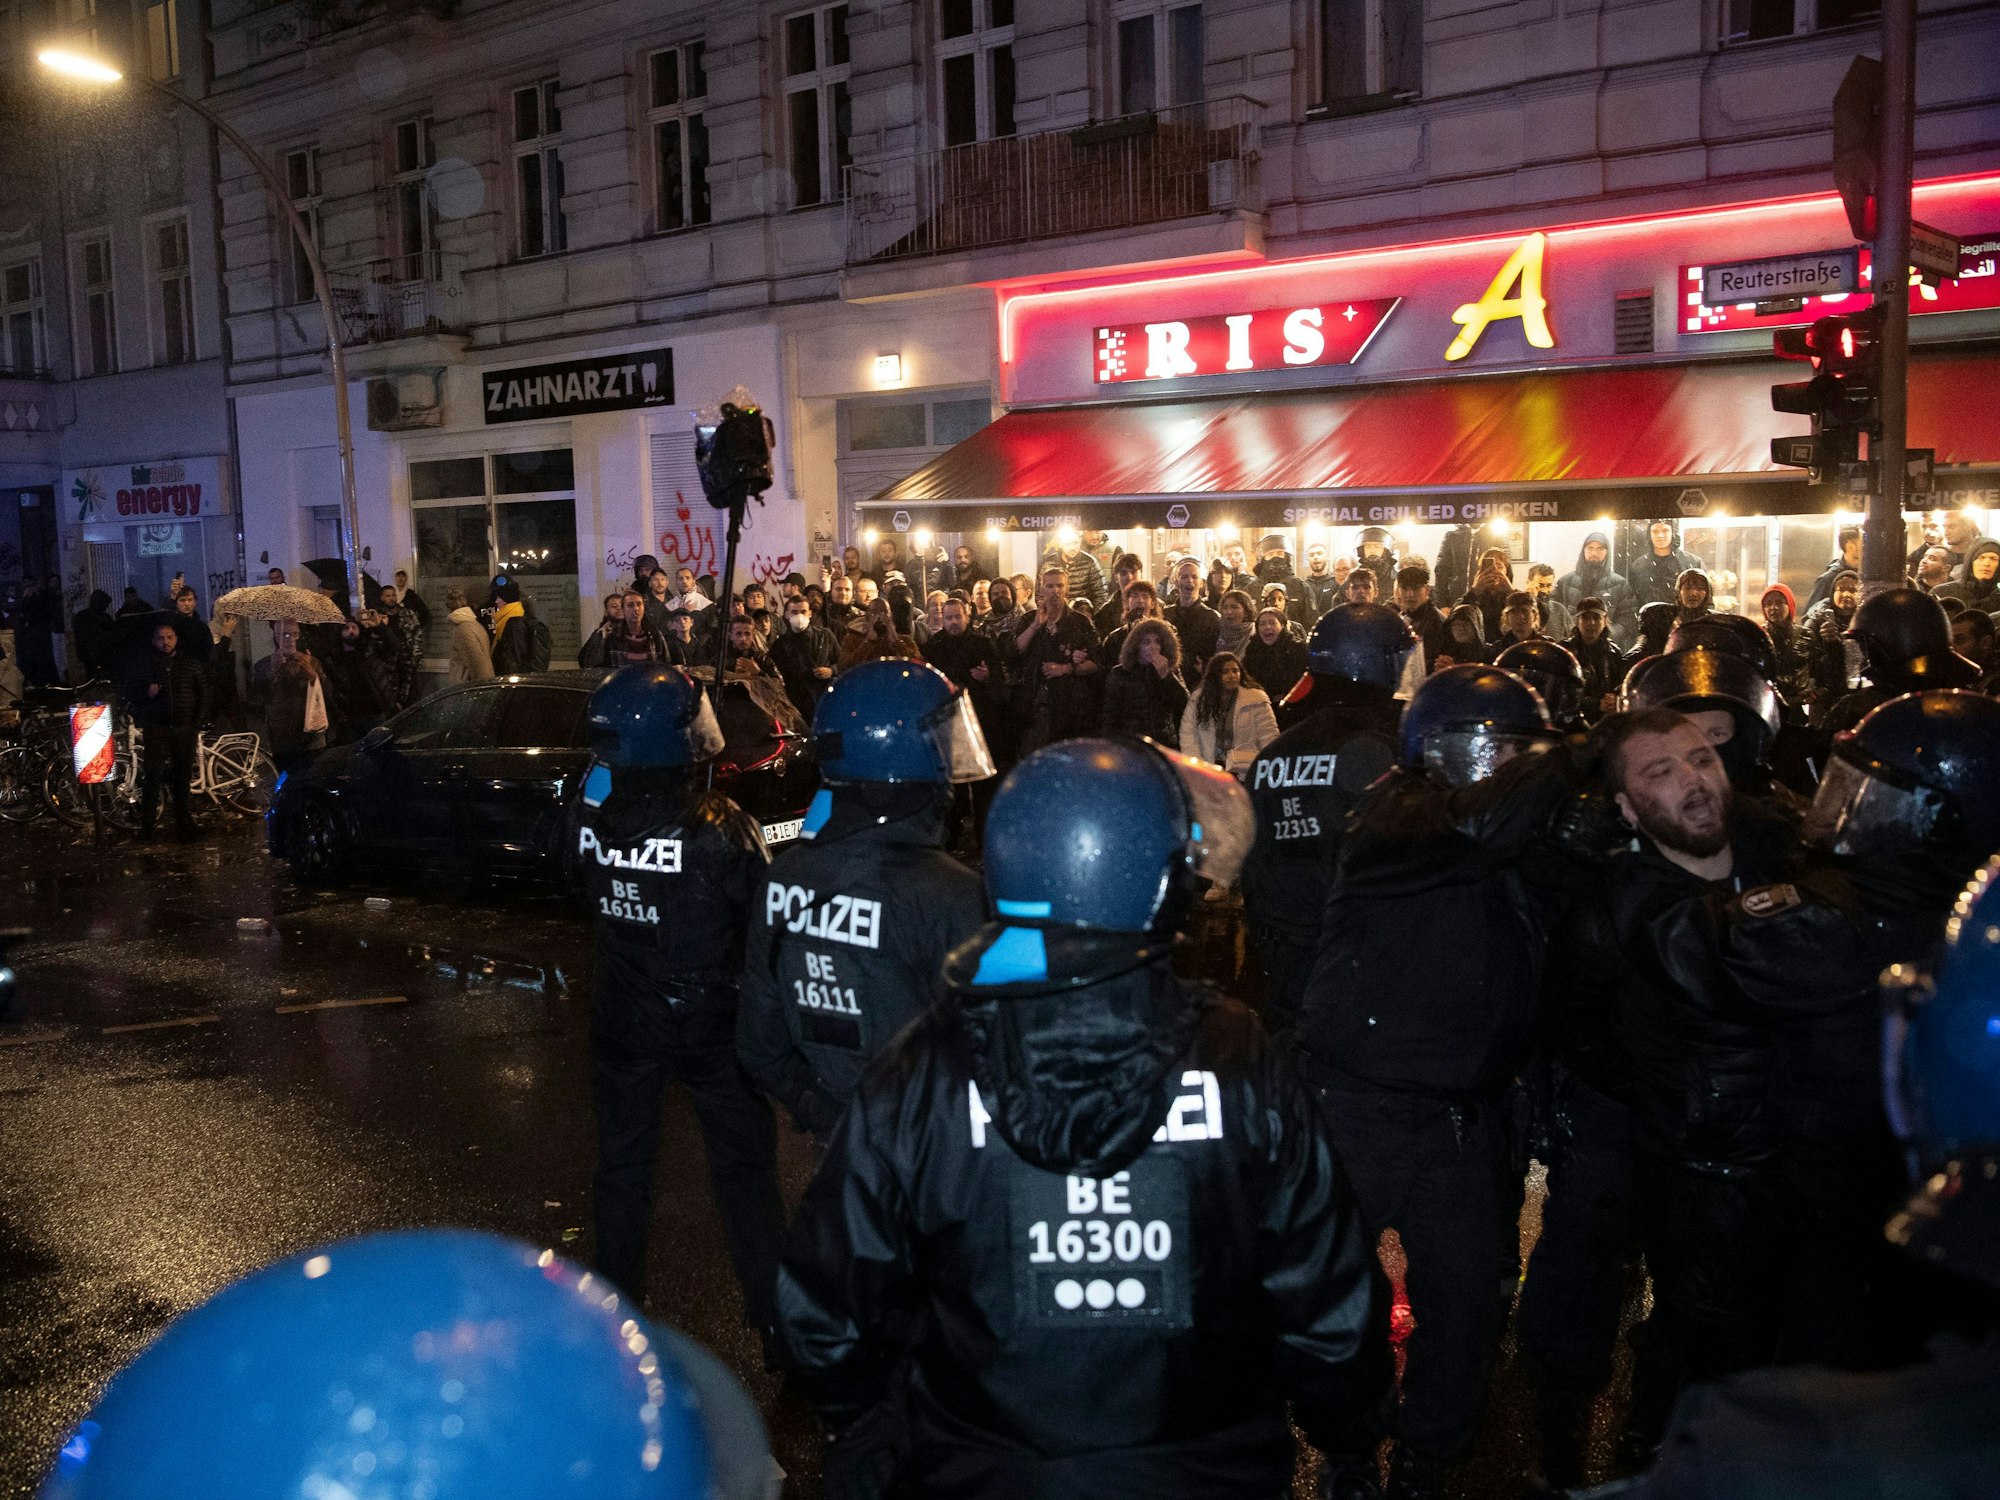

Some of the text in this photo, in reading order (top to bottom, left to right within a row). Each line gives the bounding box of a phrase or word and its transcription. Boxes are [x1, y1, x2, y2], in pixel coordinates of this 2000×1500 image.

[1721, 261, 1841, 292] Reuterstraße
[1959, 259, 1995, 278] الفح
[1445, 232, 1556, 361] A
[487, 364, 637, 412] ZAHNARZT
[116, 484, 201, 516] energy
[1283, 501, 1559, 523] SPECIAL GRILLED CHICKEN
[1253, 754, 1337, 791] POLIZEI
[1281, 796, 1303, 818] BE
[578, 826, 683, 873] POLIZEI
[611, 879, 641, 901] BE
[599, 896, 660, 925] 16114
[766, 881, 883, 949] POLIZEI
[805, 951, 838, 982] BE
[793, 980, 863, 1015] 16111
[1066, 1170, 1133, 1214] BE
[1028, 1219, 1173, 1263] 16300
